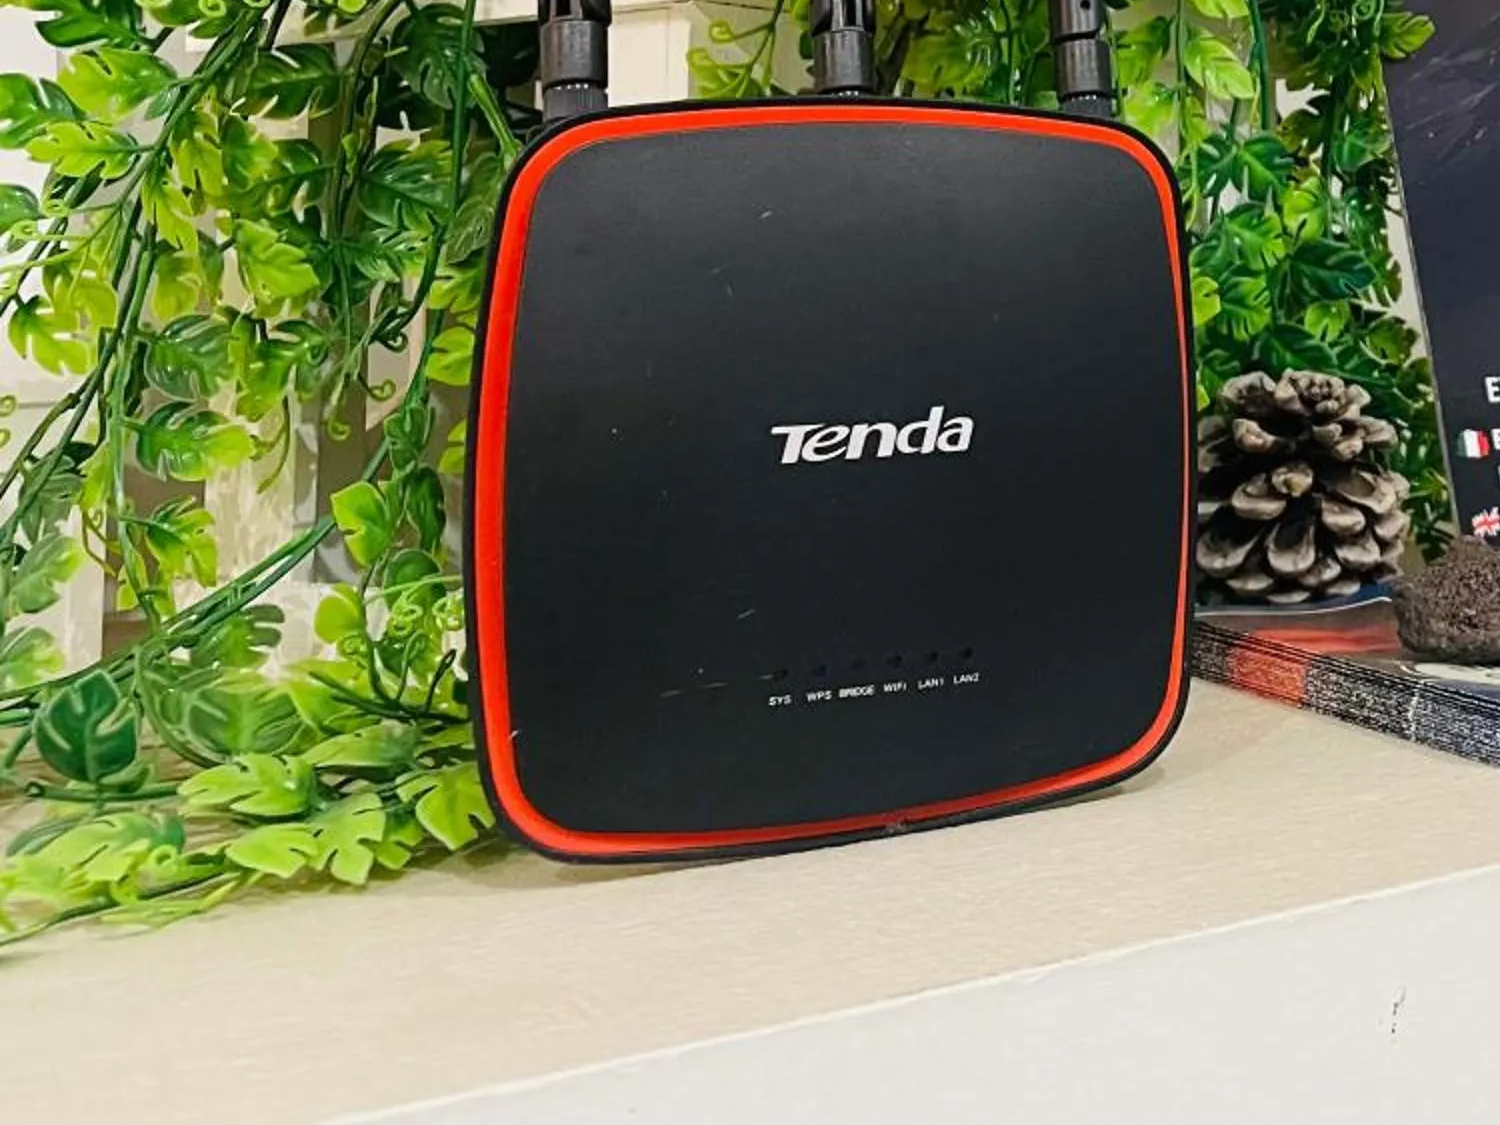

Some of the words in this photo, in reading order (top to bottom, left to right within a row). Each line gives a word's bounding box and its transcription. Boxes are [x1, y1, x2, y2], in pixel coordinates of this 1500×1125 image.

[770, 405, 975, 464] Tenda
[768, 694, 792, 706] SYS
[806, 690, 832, 702] WPS
[838, 684, 875, 698] BRIDGE
[918, 677, 944, 690] LAN1
[953, 672, 980, 685] LAN2
